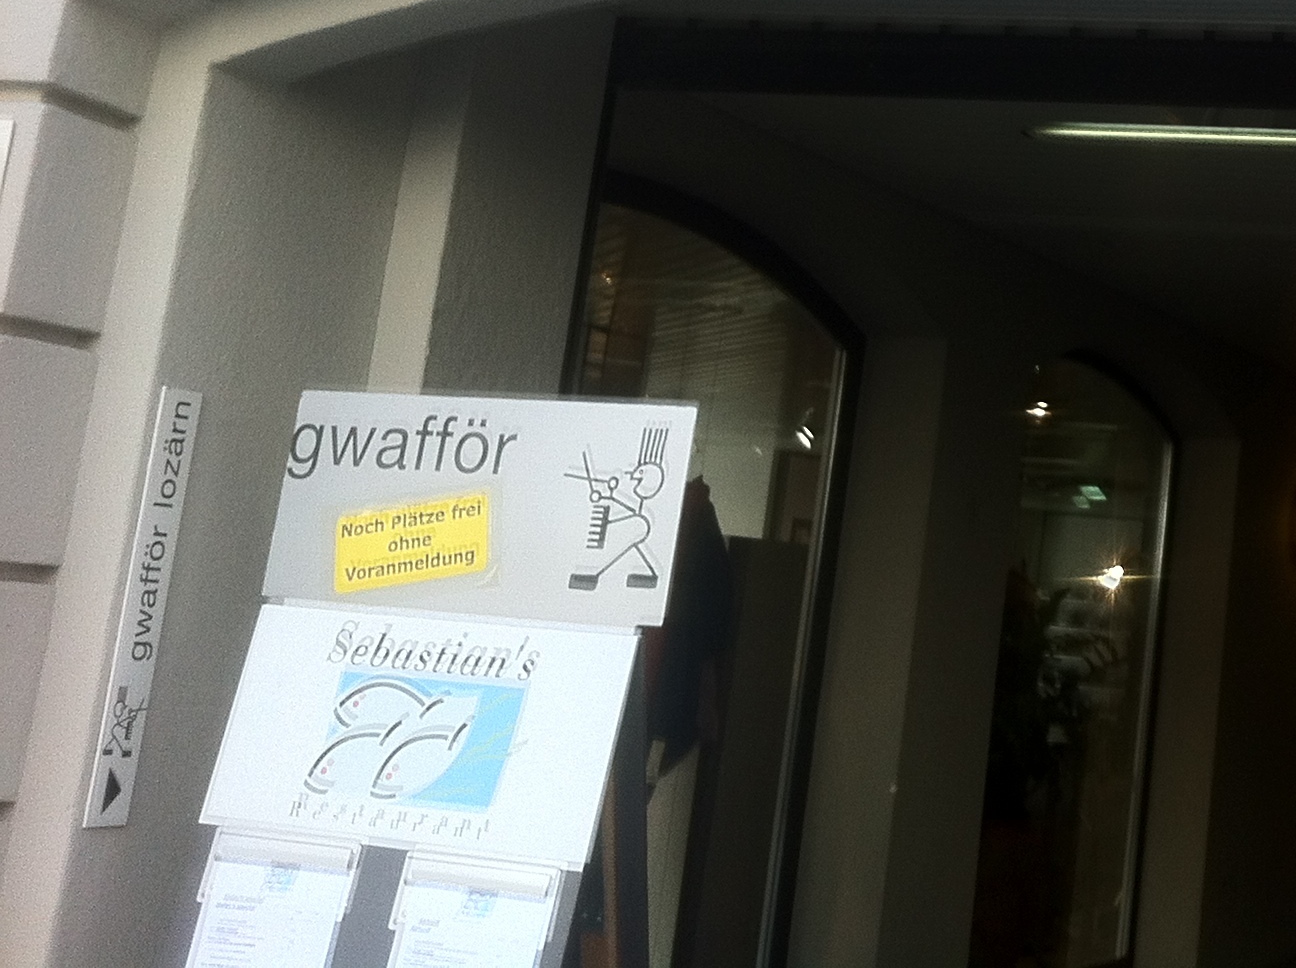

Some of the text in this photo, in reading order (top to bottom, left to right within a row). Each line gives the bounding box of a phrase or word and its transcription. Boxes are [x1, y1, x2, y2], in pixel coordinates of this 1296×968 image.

[287, 414, 518, 480] gwafför
[131, 399, 192, 662] gwafför lozärn
[341, 500, 482, 539] Noch Plätze frei
[345, 549, 476, 582] Voranmeldung
[387, 534, 432, 553] ohne
[327, 627, 536, 681] Sebastian's
